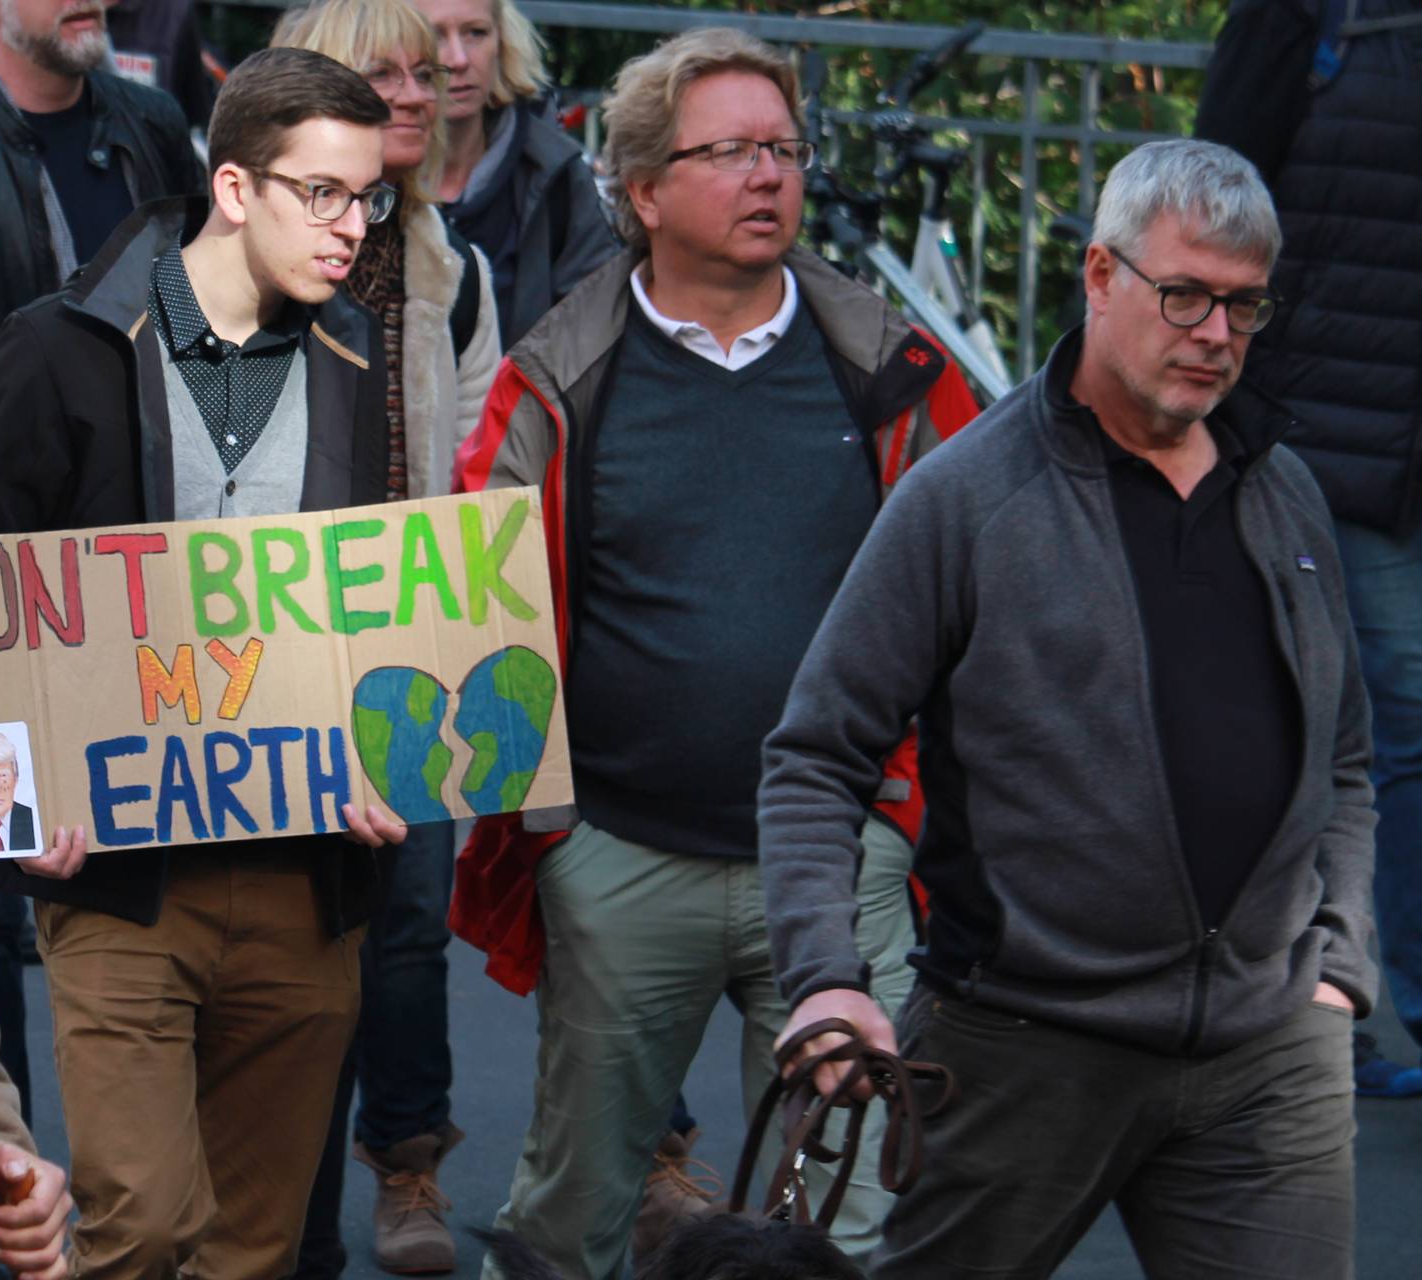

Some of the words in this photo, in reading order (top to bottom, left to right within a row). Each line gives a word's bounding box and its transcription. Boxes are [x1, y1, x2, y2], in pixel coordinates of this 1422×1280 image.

[188, 499, 540, 638] BREAK
[137, 637, 264, 725] MY
[85, 726, 352, 847] EARTH
